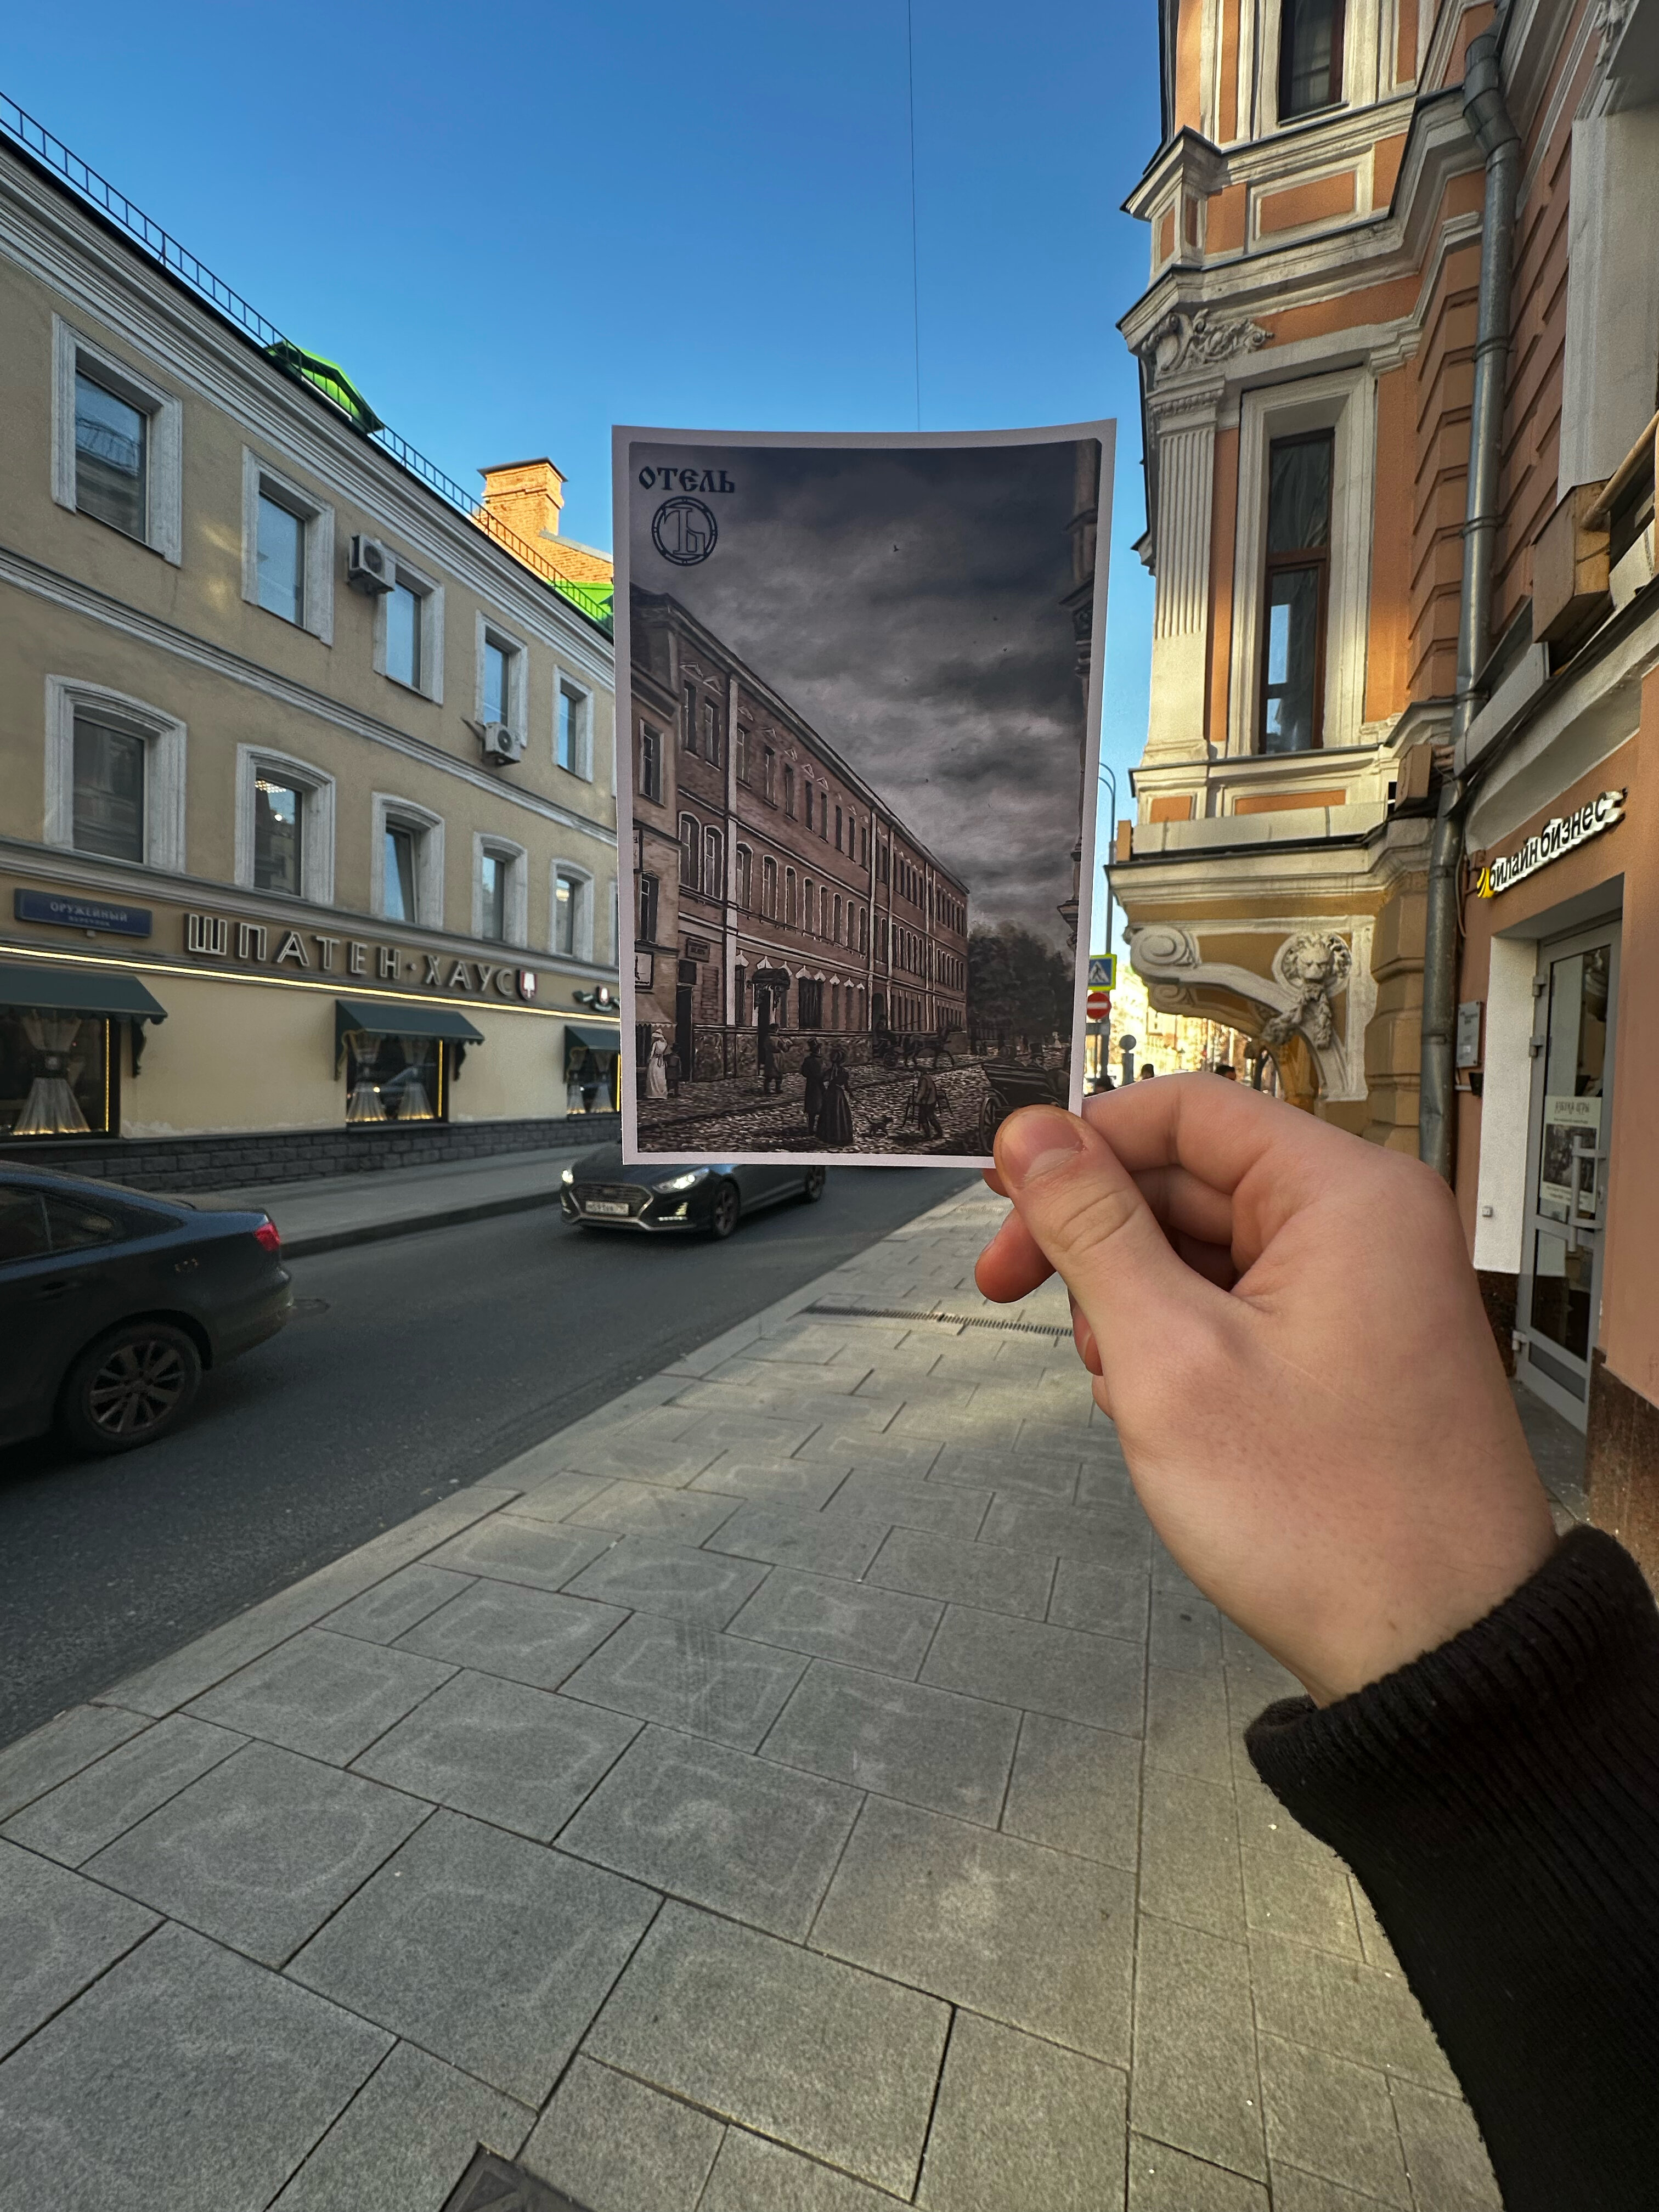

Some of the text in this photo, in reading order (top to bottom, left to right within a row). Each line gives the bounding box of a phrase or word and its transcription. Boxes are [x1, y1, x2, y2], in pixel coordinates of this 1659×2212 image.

[639, 466, 735, 493] ОТЕЛЬ
[1489, 791, 1607, 891] билайн бизнес
[50, 901, 127, 922] ОРУЖЕЙНЫЙ
